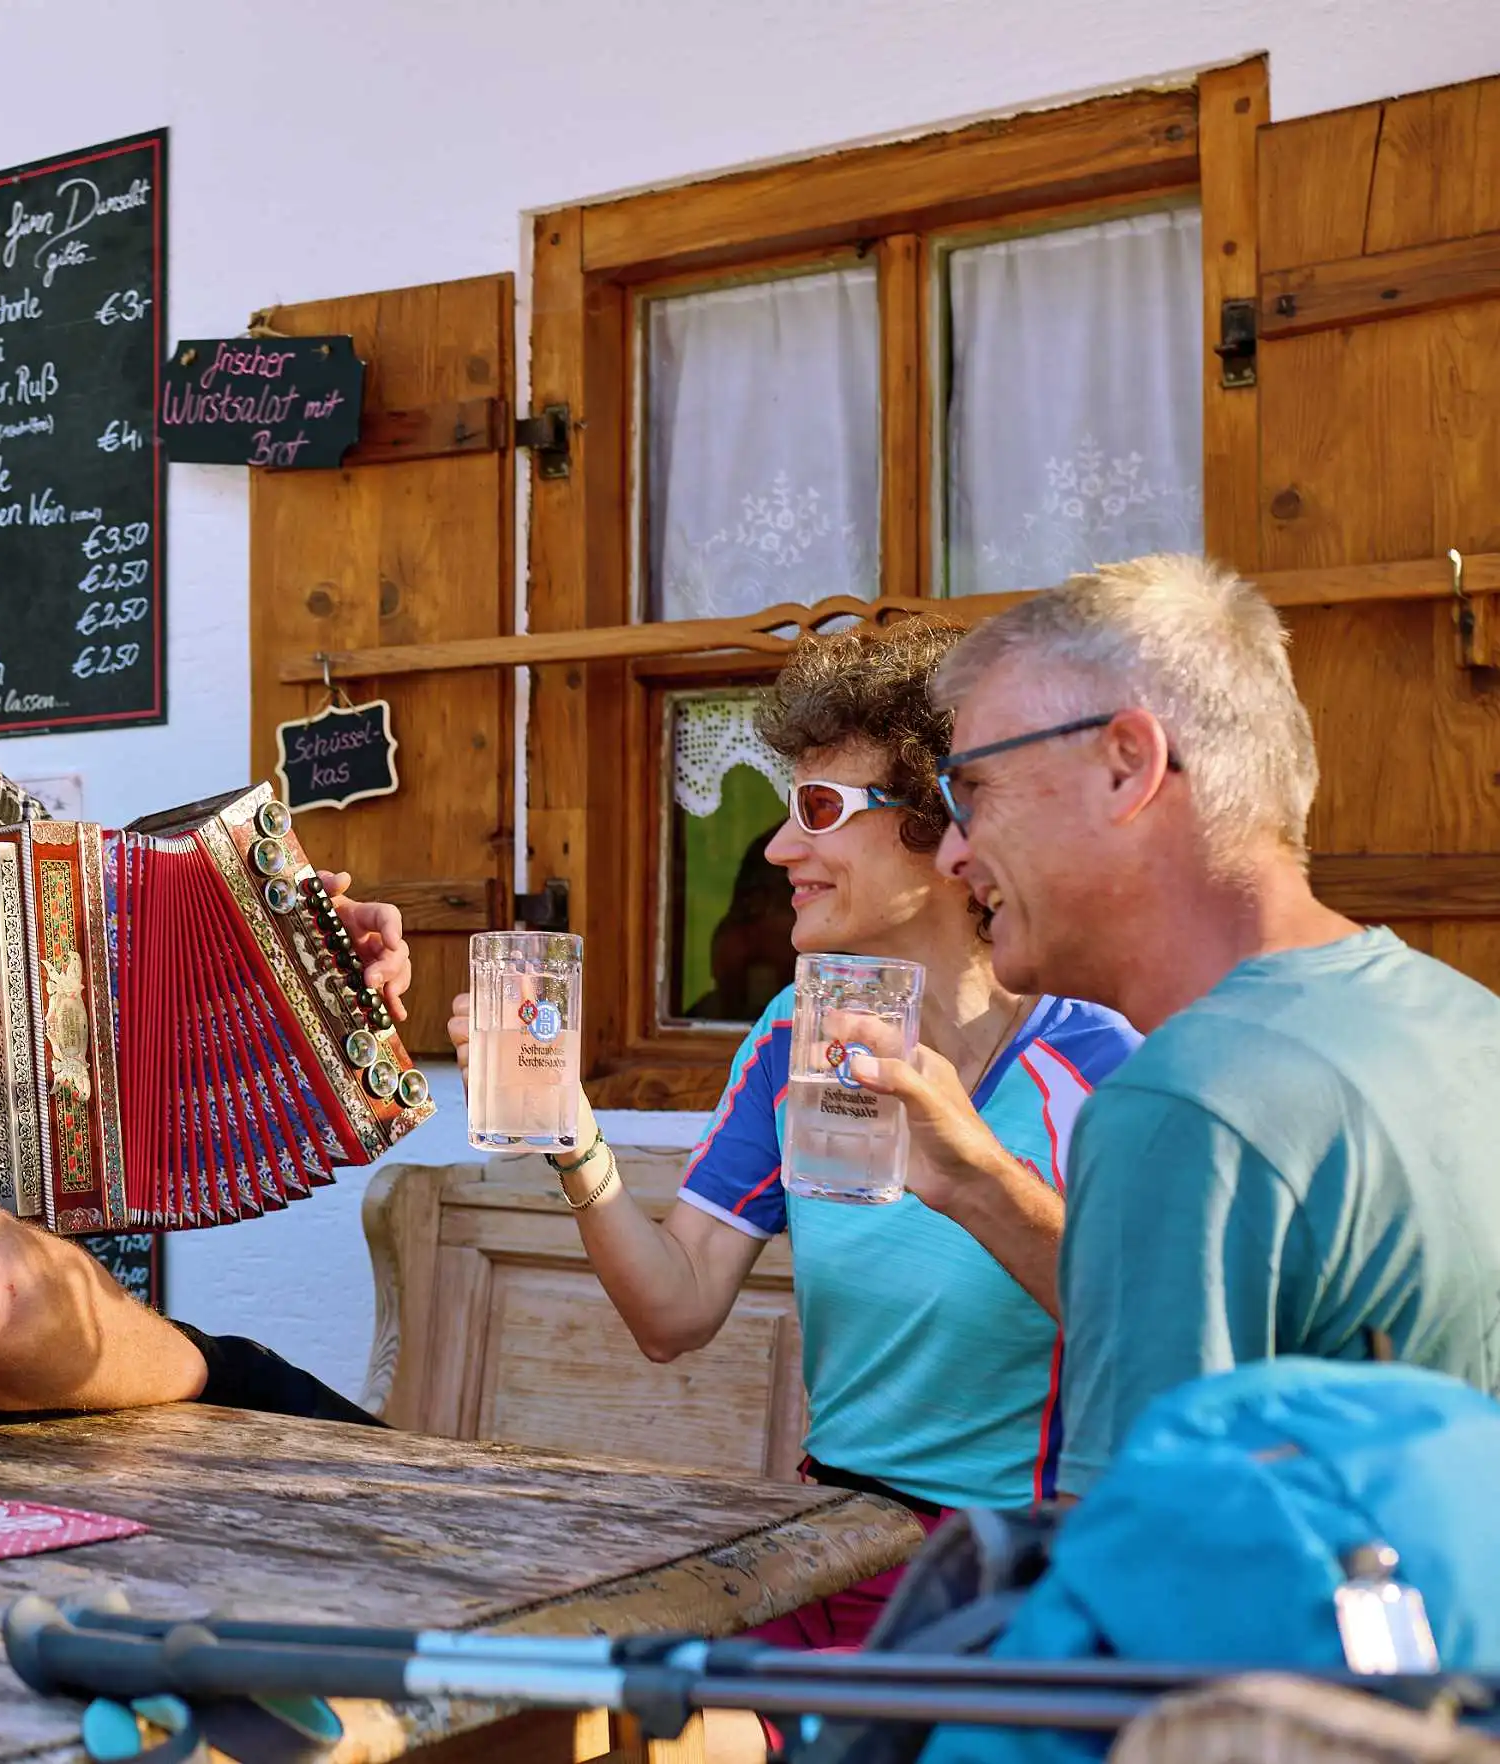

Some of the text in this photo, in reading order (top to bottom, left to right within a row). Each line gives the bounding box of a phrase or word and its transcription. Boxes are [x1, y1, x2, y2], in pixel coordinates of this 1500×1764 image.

[15, 362, 60, 405] Ruß
[163, 381, 345, 425] Wurstsalat mit
[247, 430, 310, 466] Brot
[29, 488, 66, 526] Wein
[77, 559, 148, 594] €2,50
[75, 597, 148, 636] €2,50
[71, 643, 140, 679] €2,50
